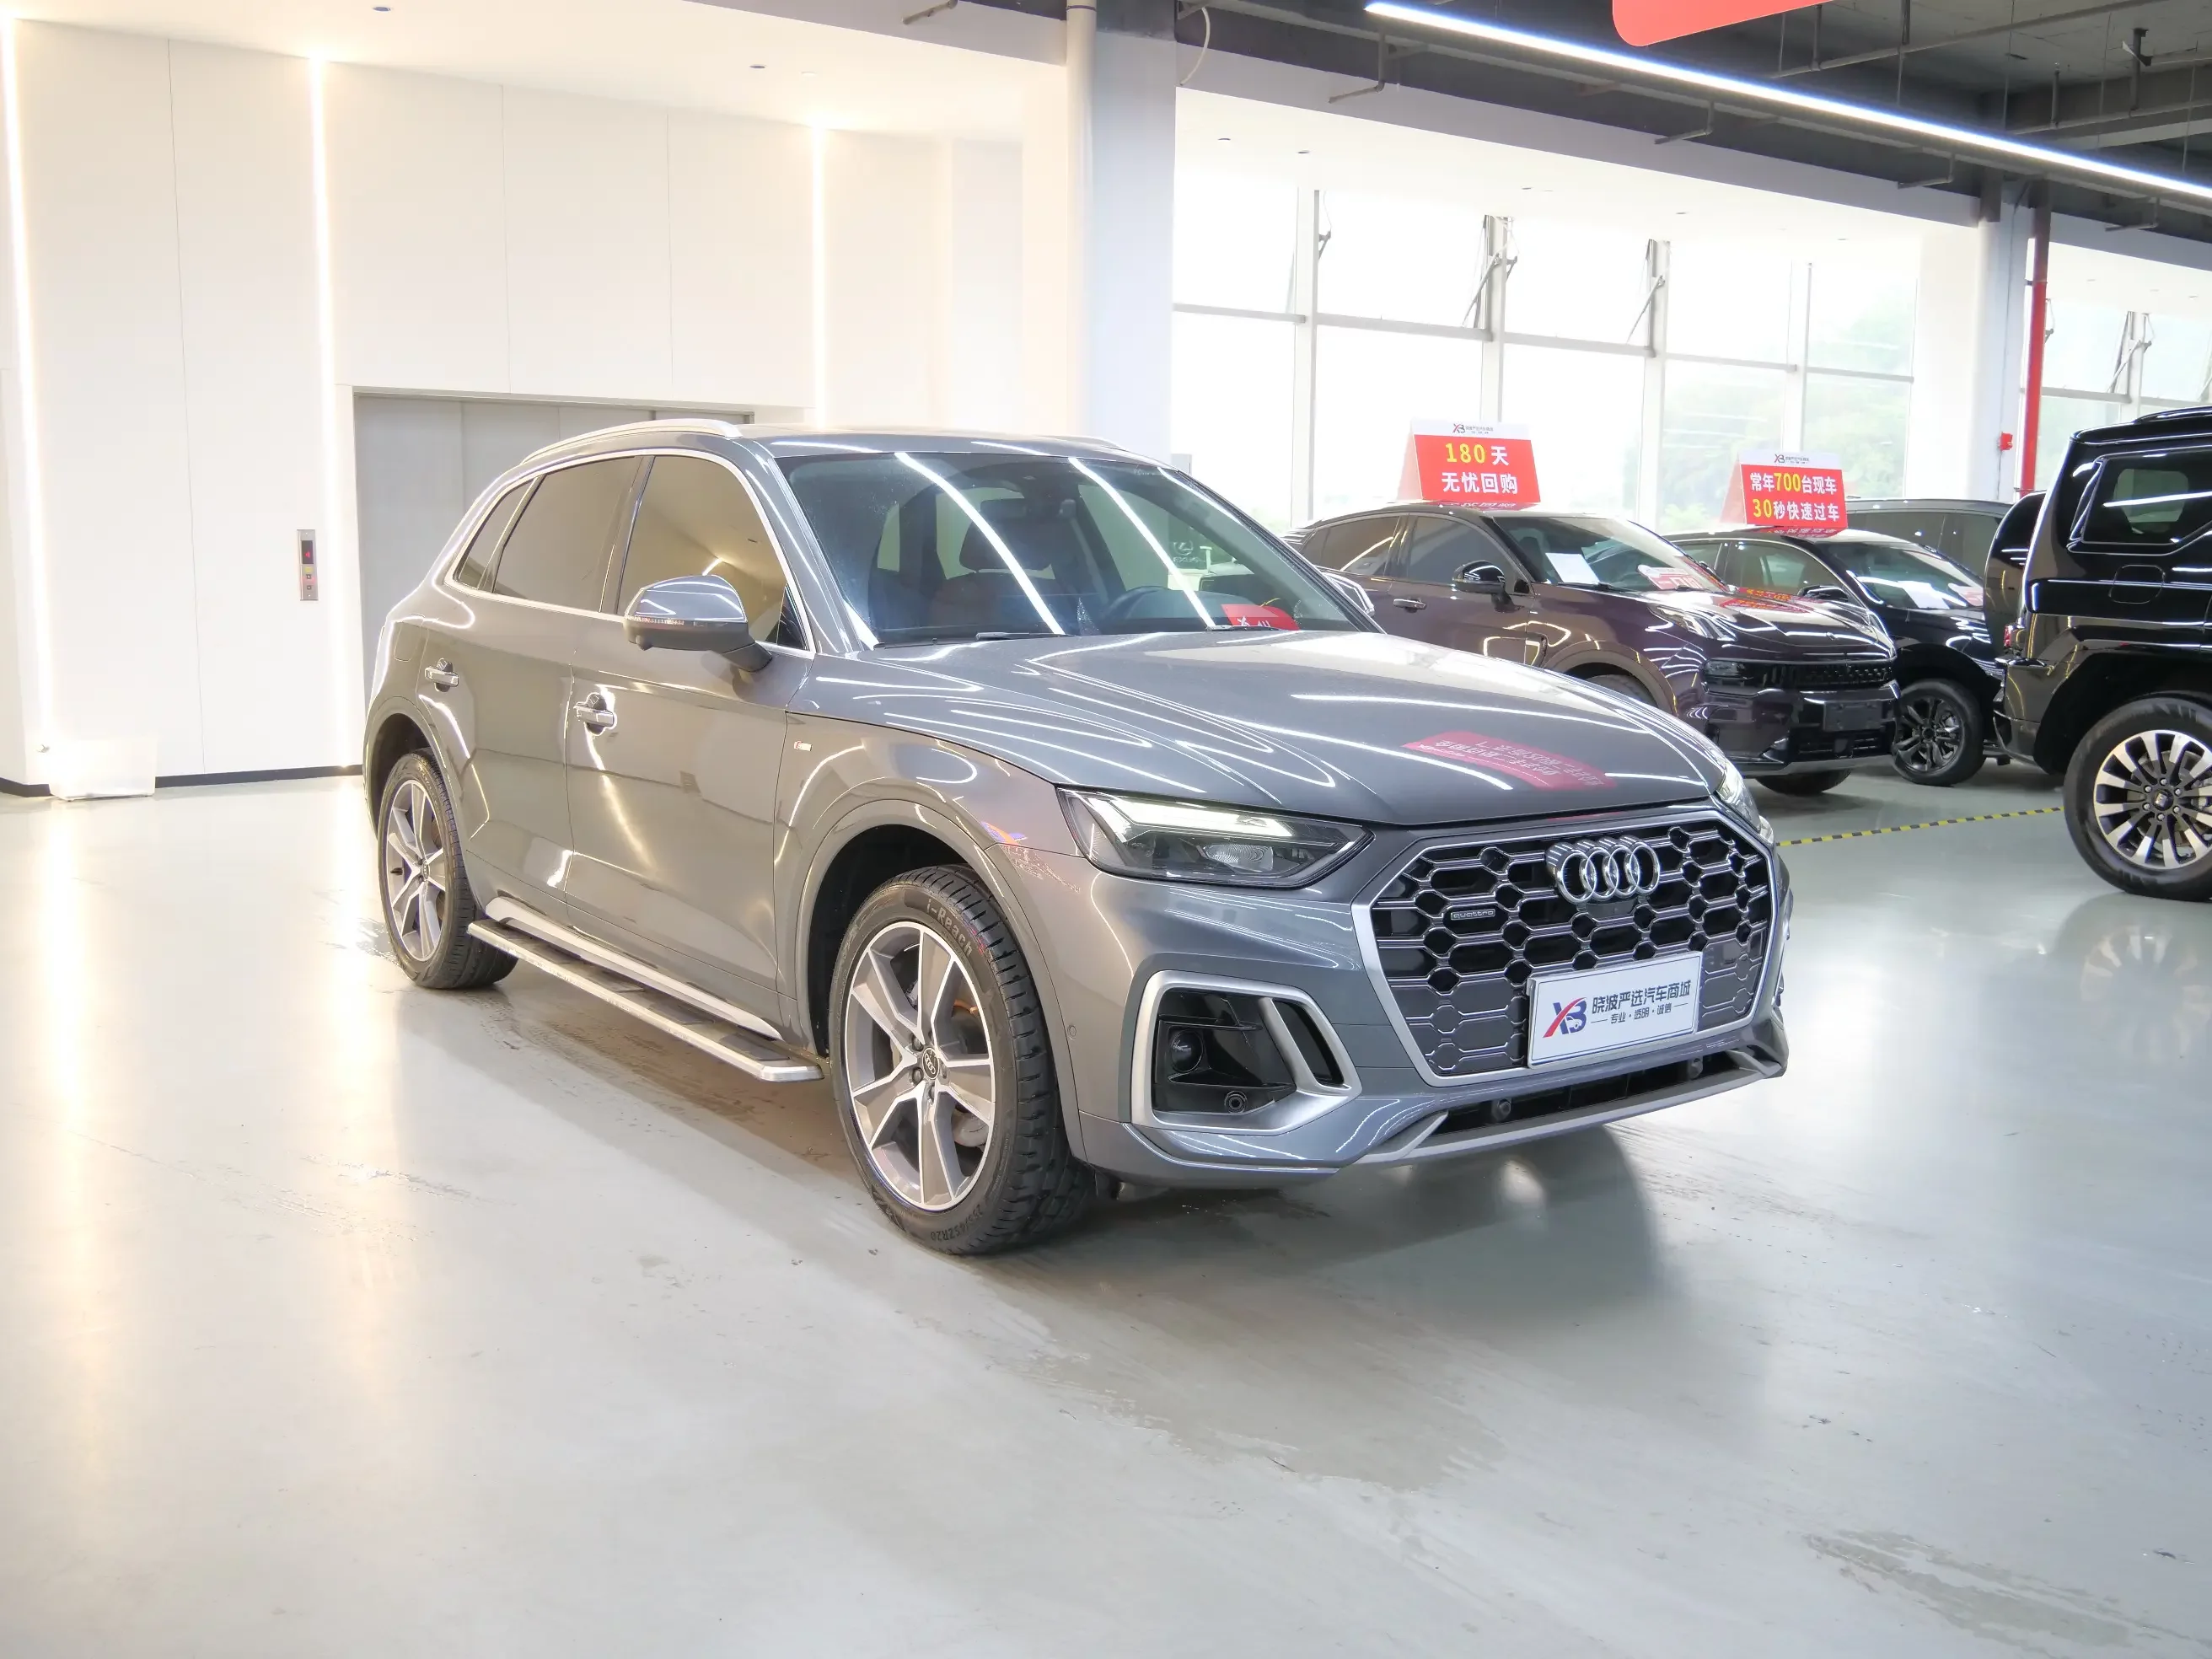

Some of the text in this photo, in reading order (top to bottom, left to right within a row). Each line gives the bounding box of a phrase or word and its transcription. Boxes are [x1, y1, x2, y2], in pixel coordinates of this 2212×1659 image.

[1445, 443, 1509, 465] 180天
[1442, 472, 1517, 494] 无忧回购
[1750, 472, 1837, 495] 常年700台现车
[1753, 498, 1840, 522] 30秒快速过车
[1452, 910, 1495, 919] quattro
[927, 899, 973, 957] i-Reach
[1592, 980, 1691, 1014] 晓波严选汽车商城
